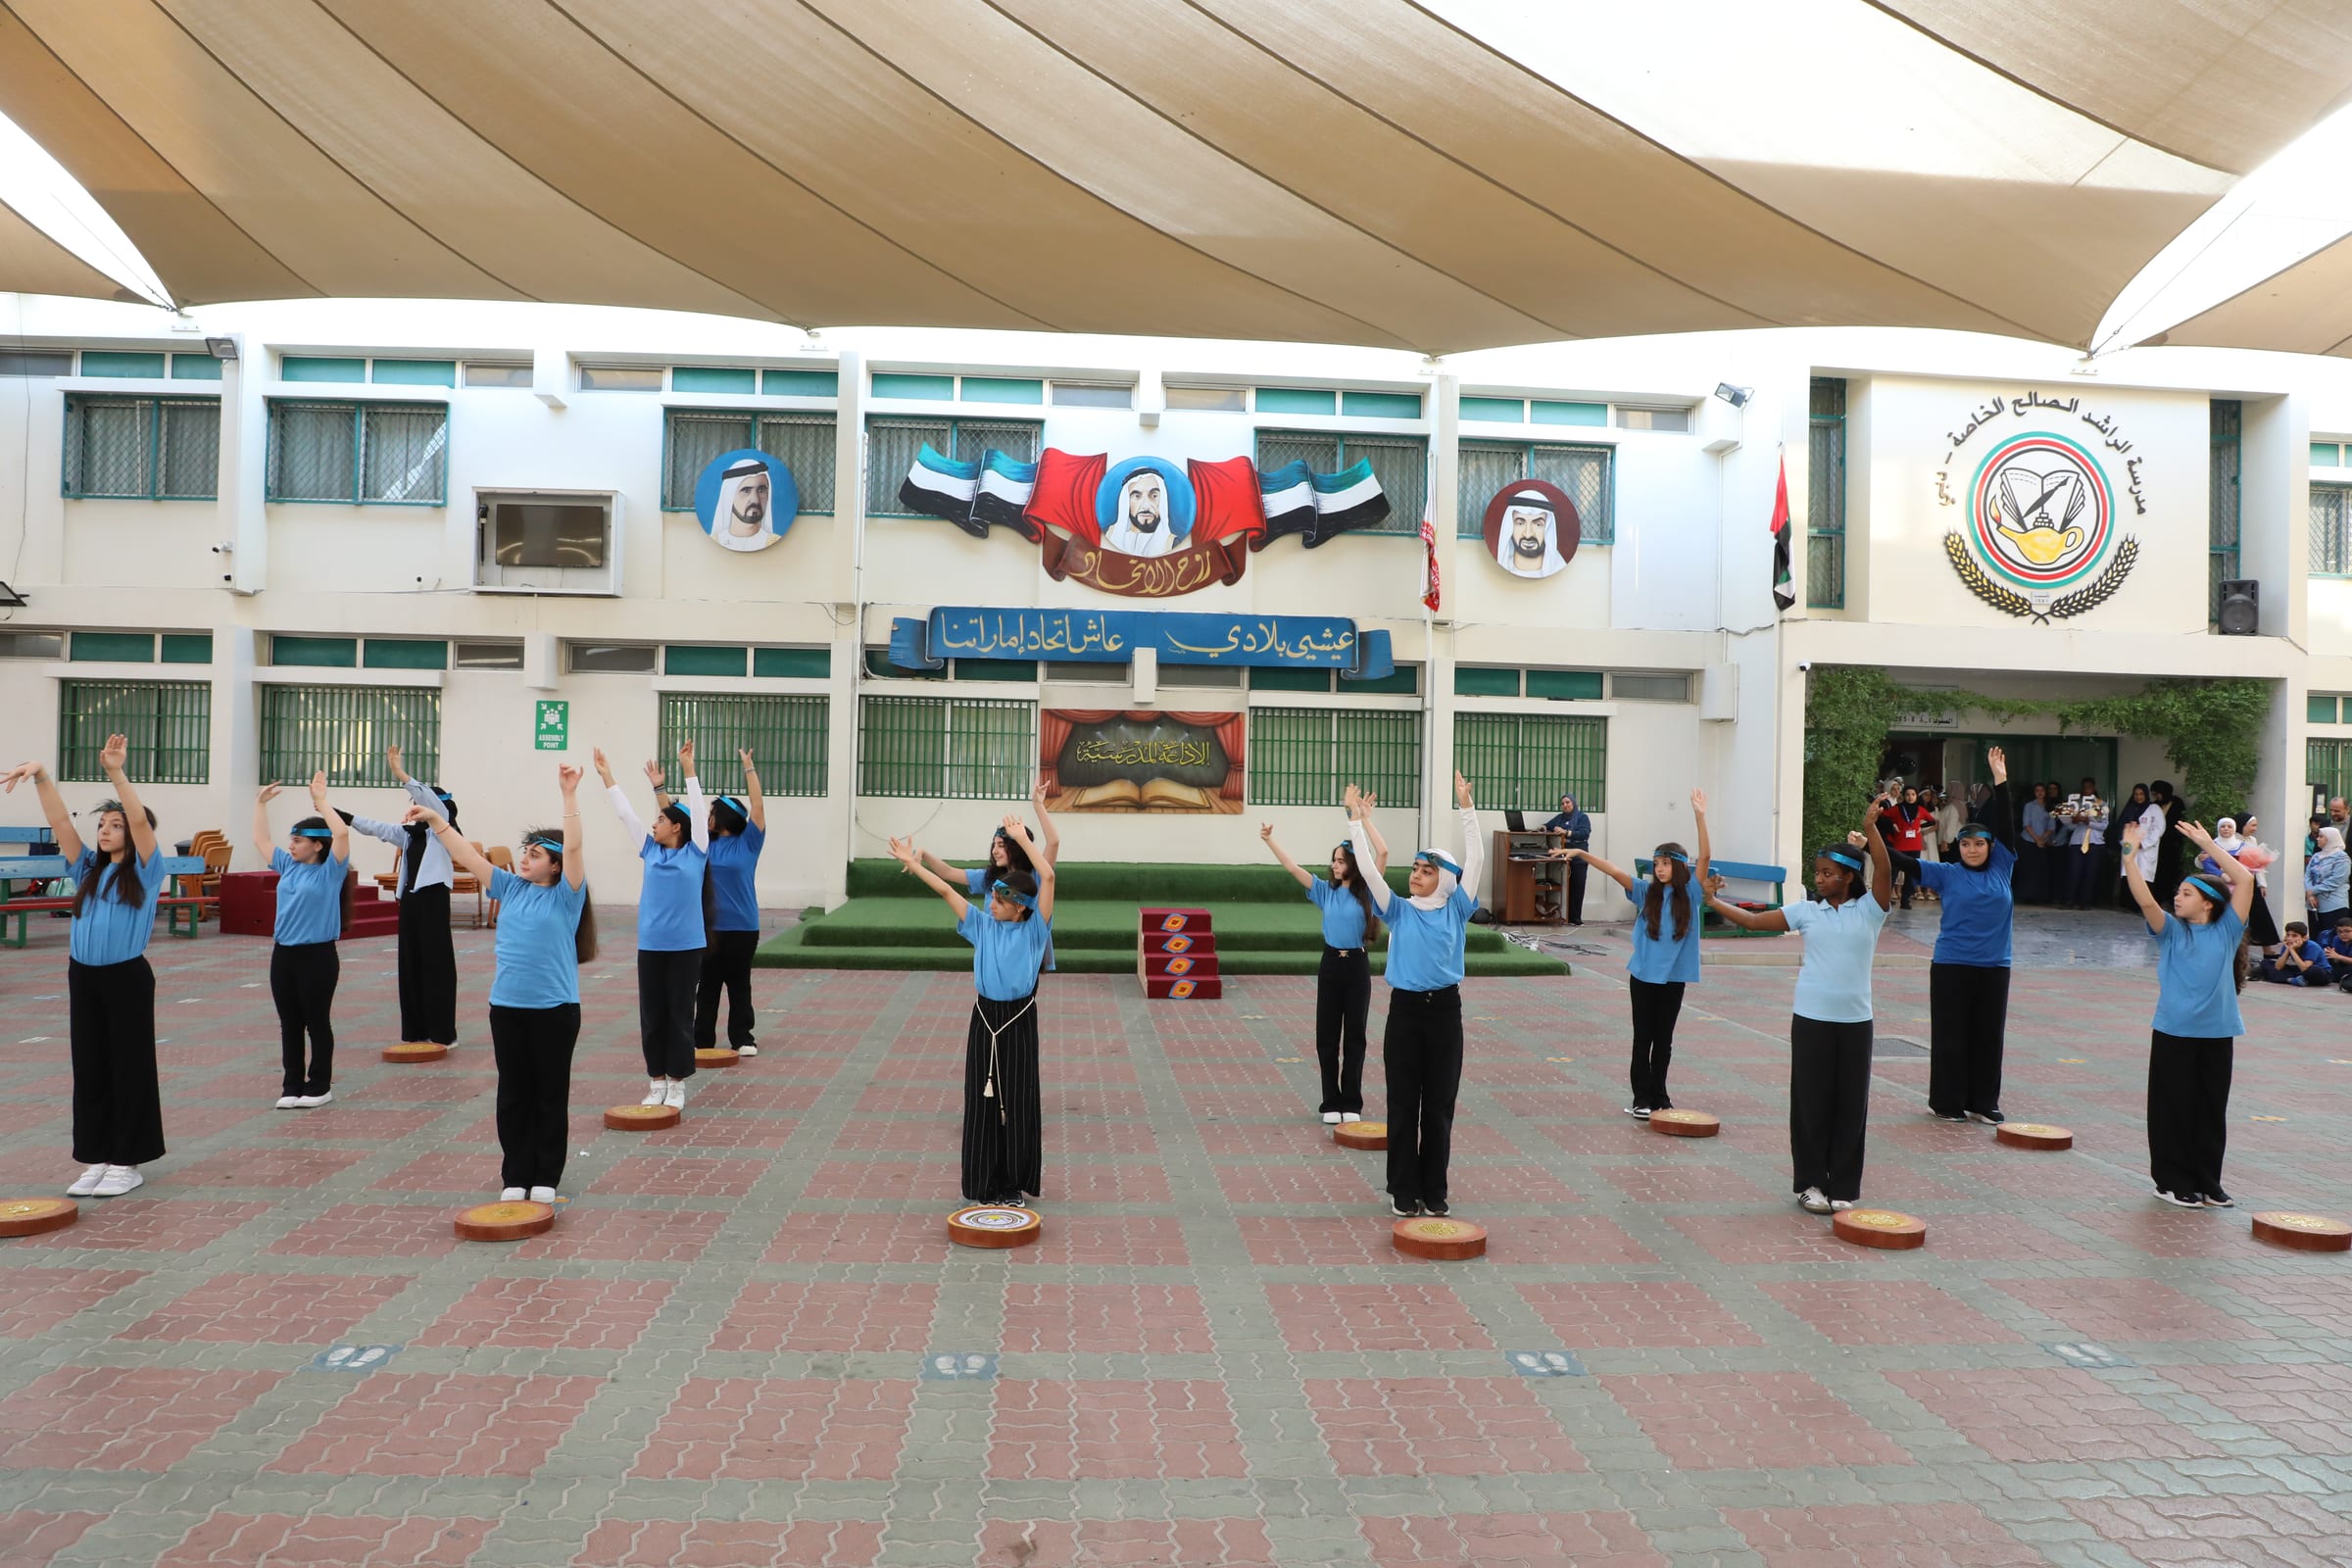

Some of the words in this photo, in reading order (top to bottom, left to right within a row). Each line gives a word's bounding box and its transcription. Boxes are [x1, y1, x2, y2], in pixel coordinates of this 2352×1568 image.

[1947, 396, 2004, 447] الخاصة
[2012, 391, 2079, 416] الصالح
[1176, 550, 1211, 591] روح
[941, 612, 1025, 656] إماراتنا
[1068, 613, 1124, 654] عاش
[1164, 619, 1287, 659] بلادي
[1286, 627, 1354, 661] عيشي
